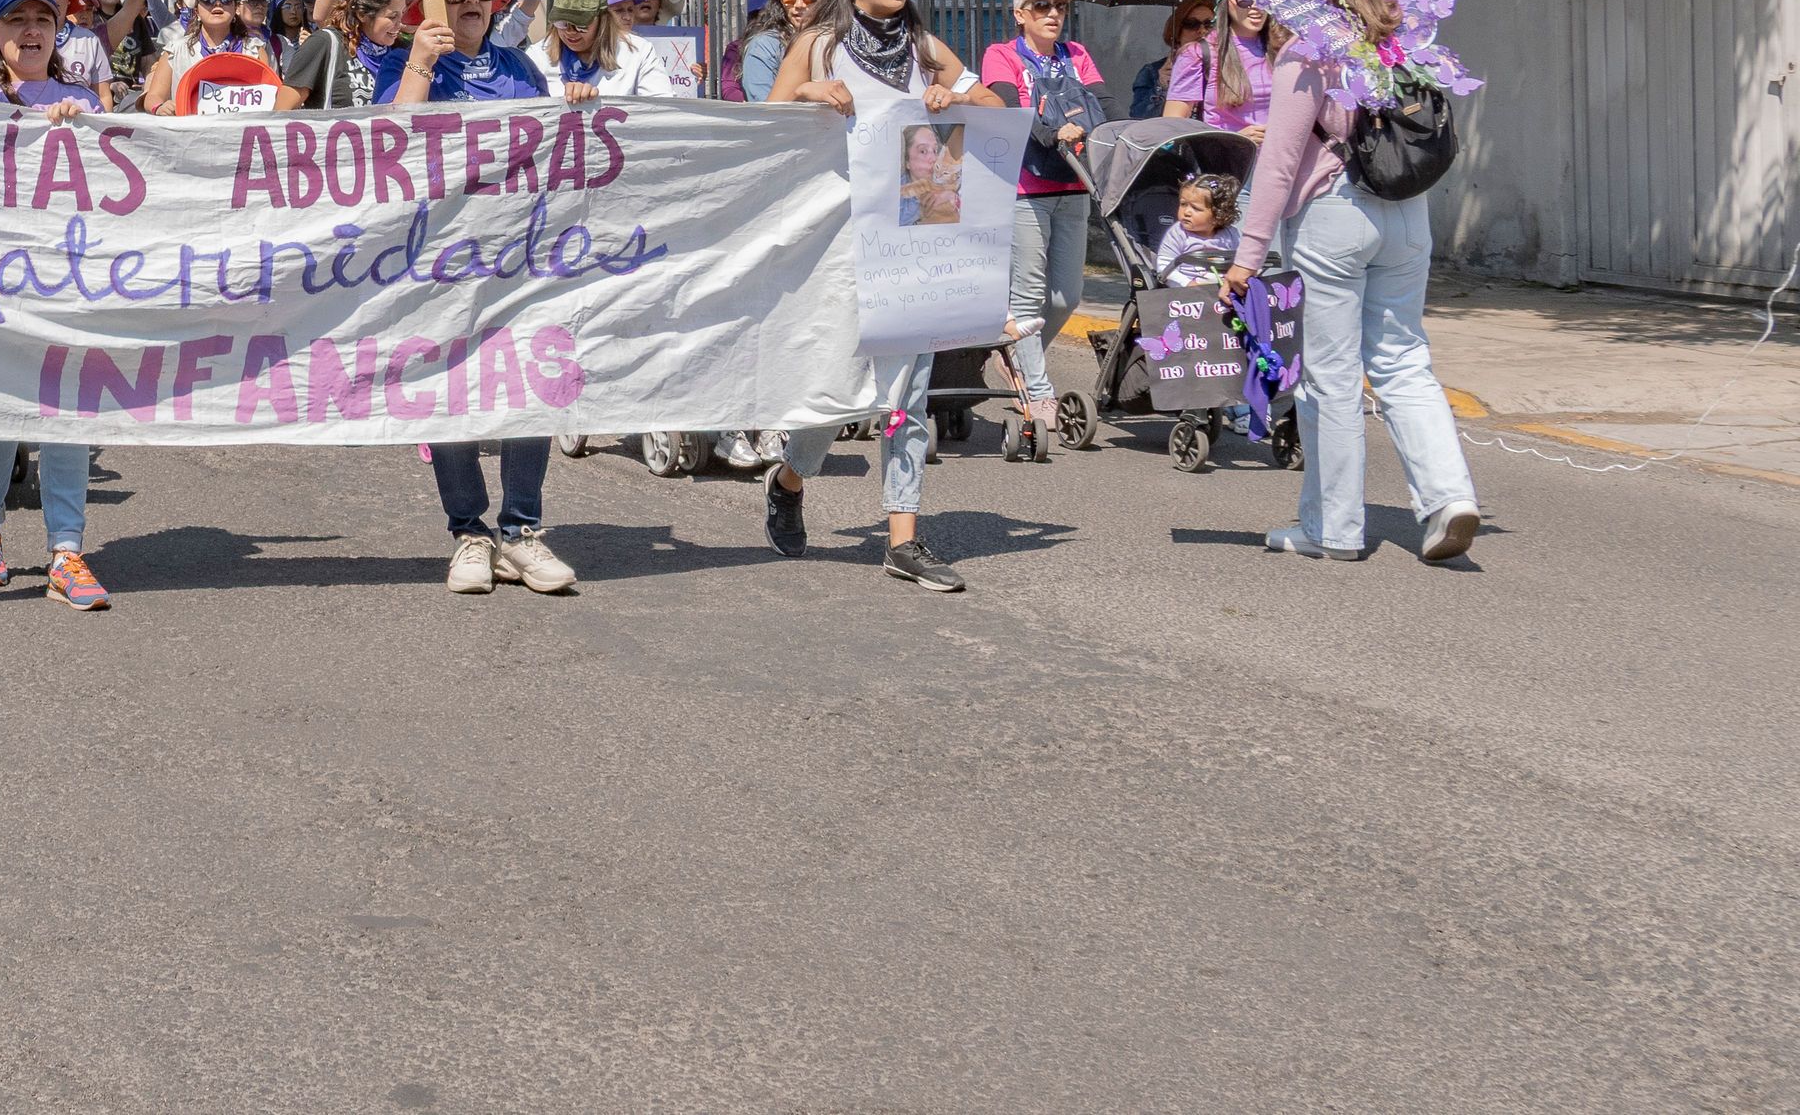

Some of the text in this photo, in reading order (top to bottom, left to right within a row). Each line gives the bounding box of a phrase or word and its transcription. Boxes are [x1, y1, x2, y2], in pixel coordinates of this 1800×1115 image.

[200, 82, 263, 107] De niña
[856, 121, 890, 146] 8M
[231, 106, 629, 209] ABORTERAS
[860, 227, 998, 260] Marcho por mi
[863, 255, 999, 285] amiga Sara porque
[866, 284, 983, 311] ella ya no puede
[1168, 300, 1204, 320] Soy
[1184, 333, 1208, 350] de
[1222, 333, 1242, 350] la
[38, 324, 586, 424] INFANCIAS
[1194, 360, 1242, 378] tiene
